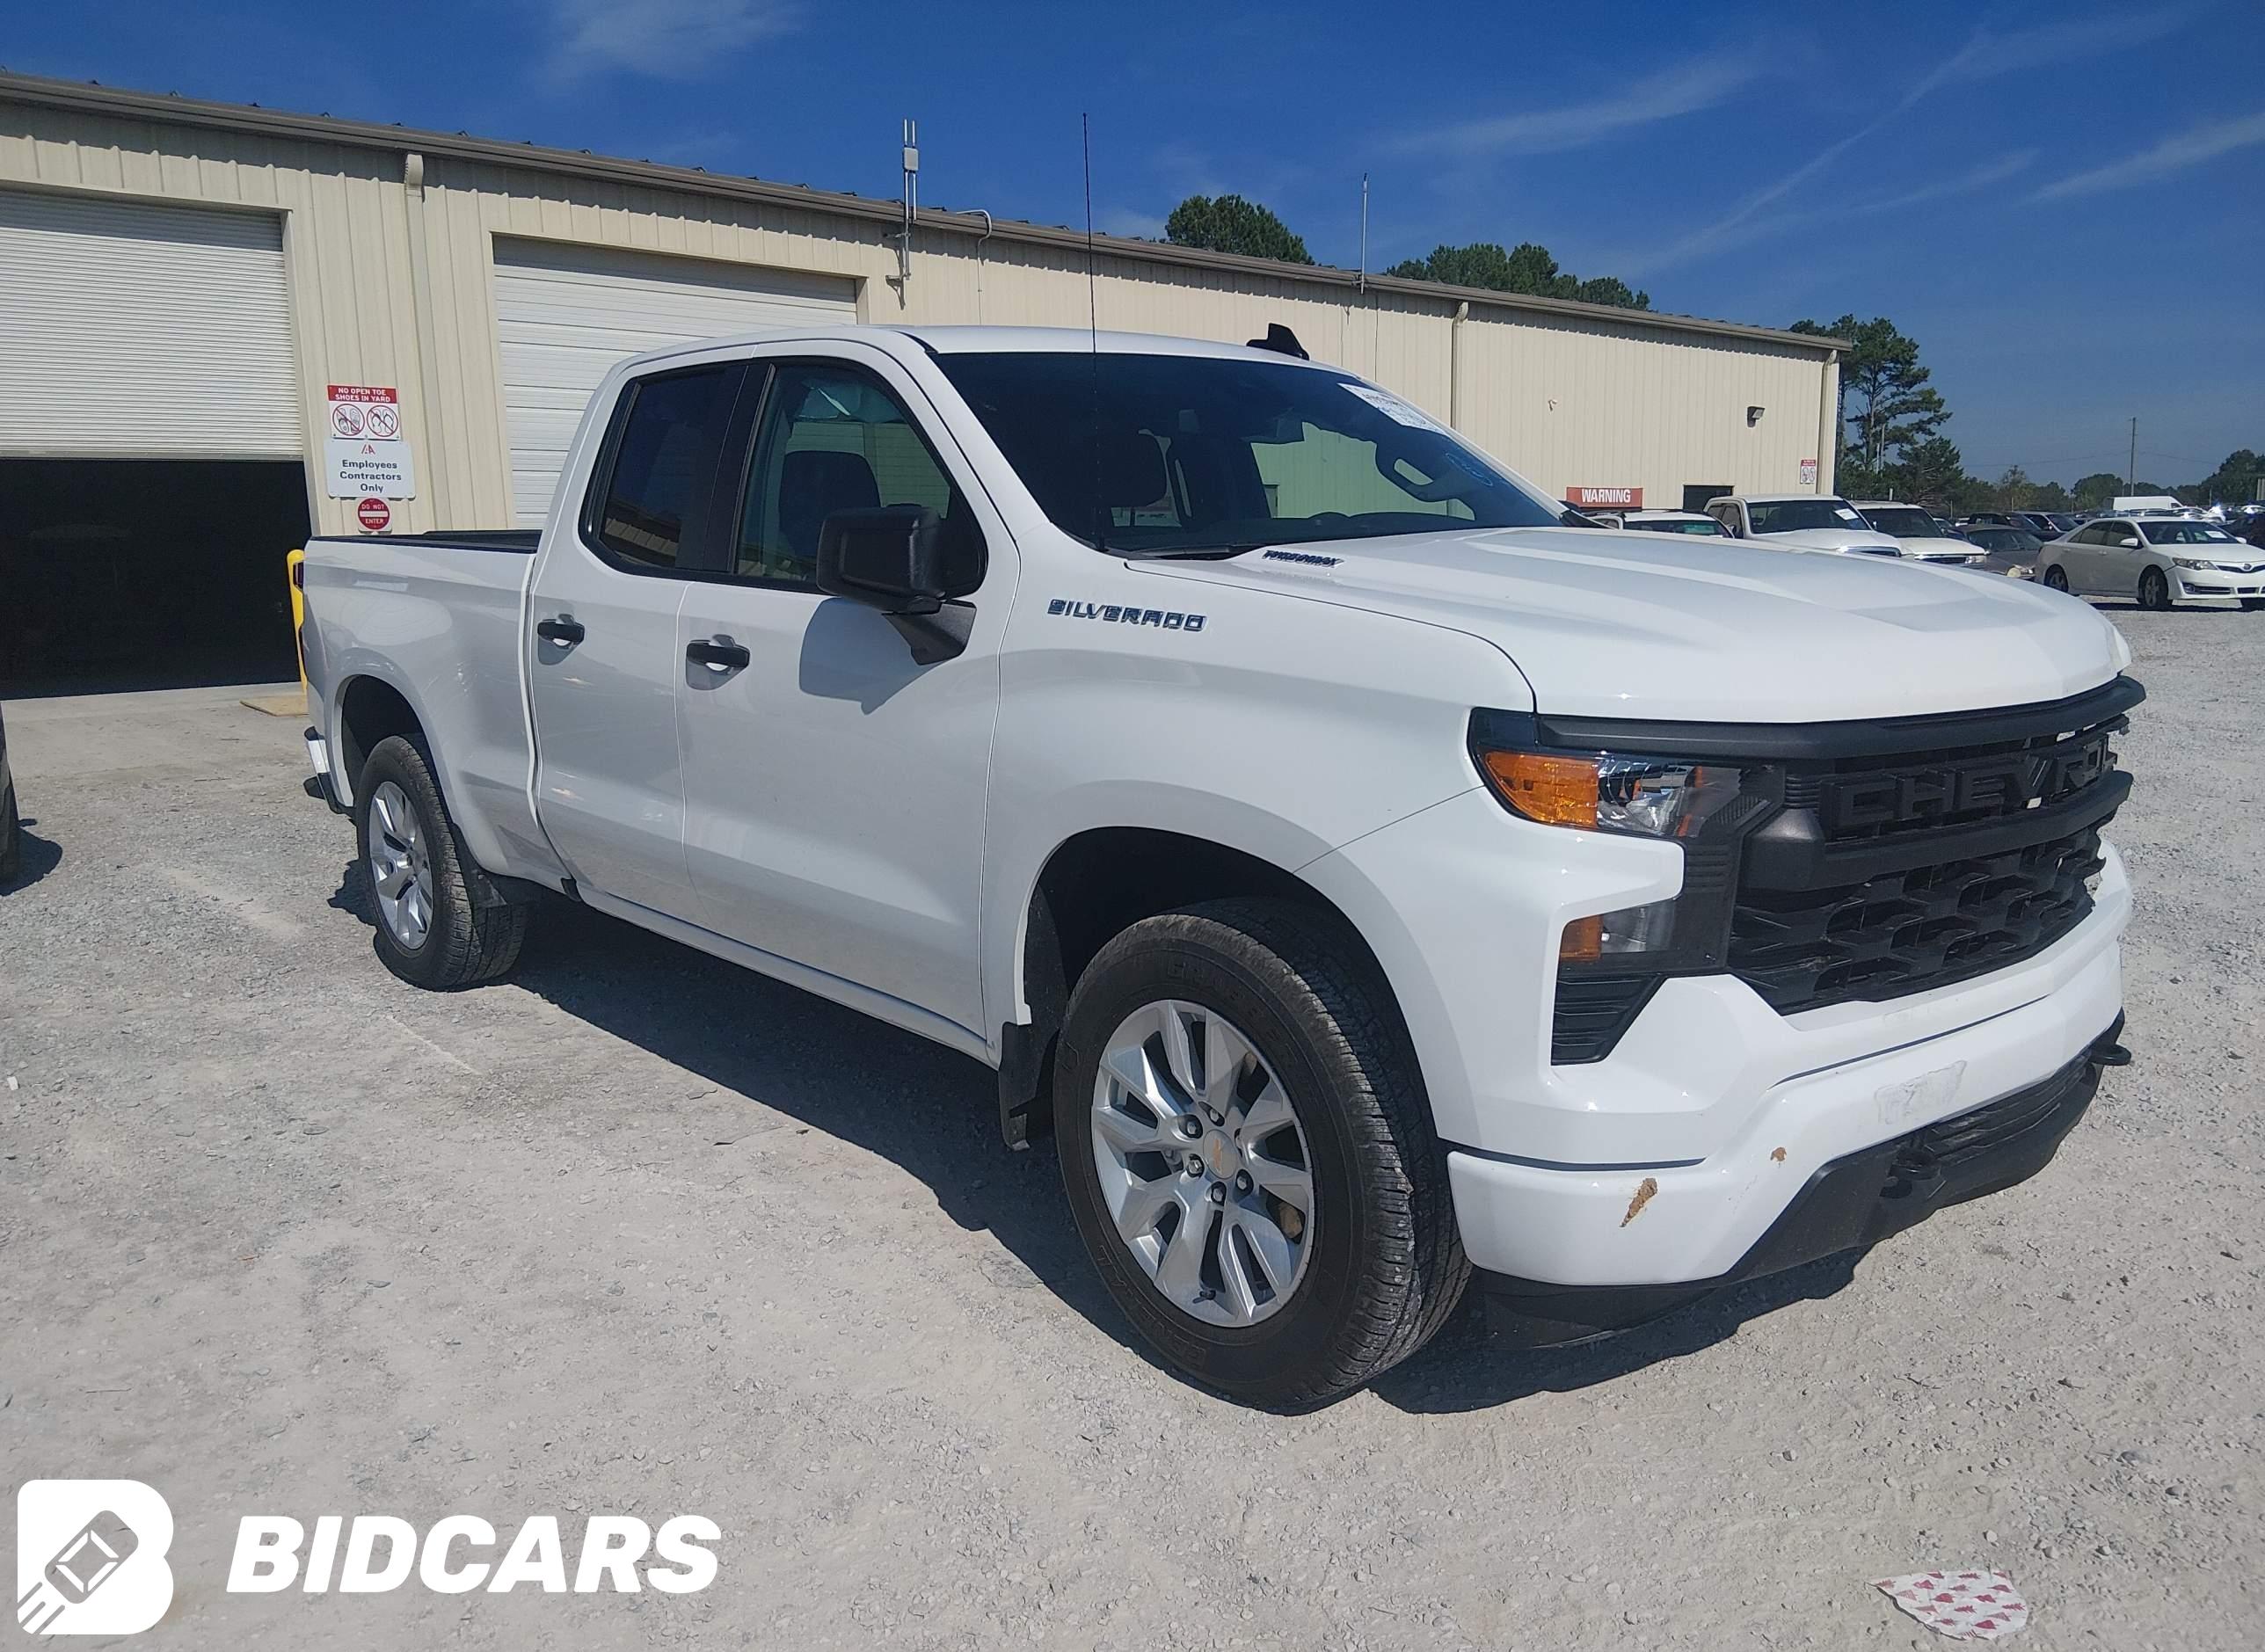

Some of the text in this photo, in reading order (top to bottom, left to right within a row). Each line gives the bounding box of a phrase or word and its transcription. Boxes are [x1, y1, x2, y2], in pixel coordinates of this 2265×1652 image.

[342, 459, 397, 470] Employees
[339, 470, 402, 481] Contractors
[361, 483, 383, 493] Only
[1581, 488, 1631, 503] WARNING
[1046, 598, 1208, 632] SILVERADO
